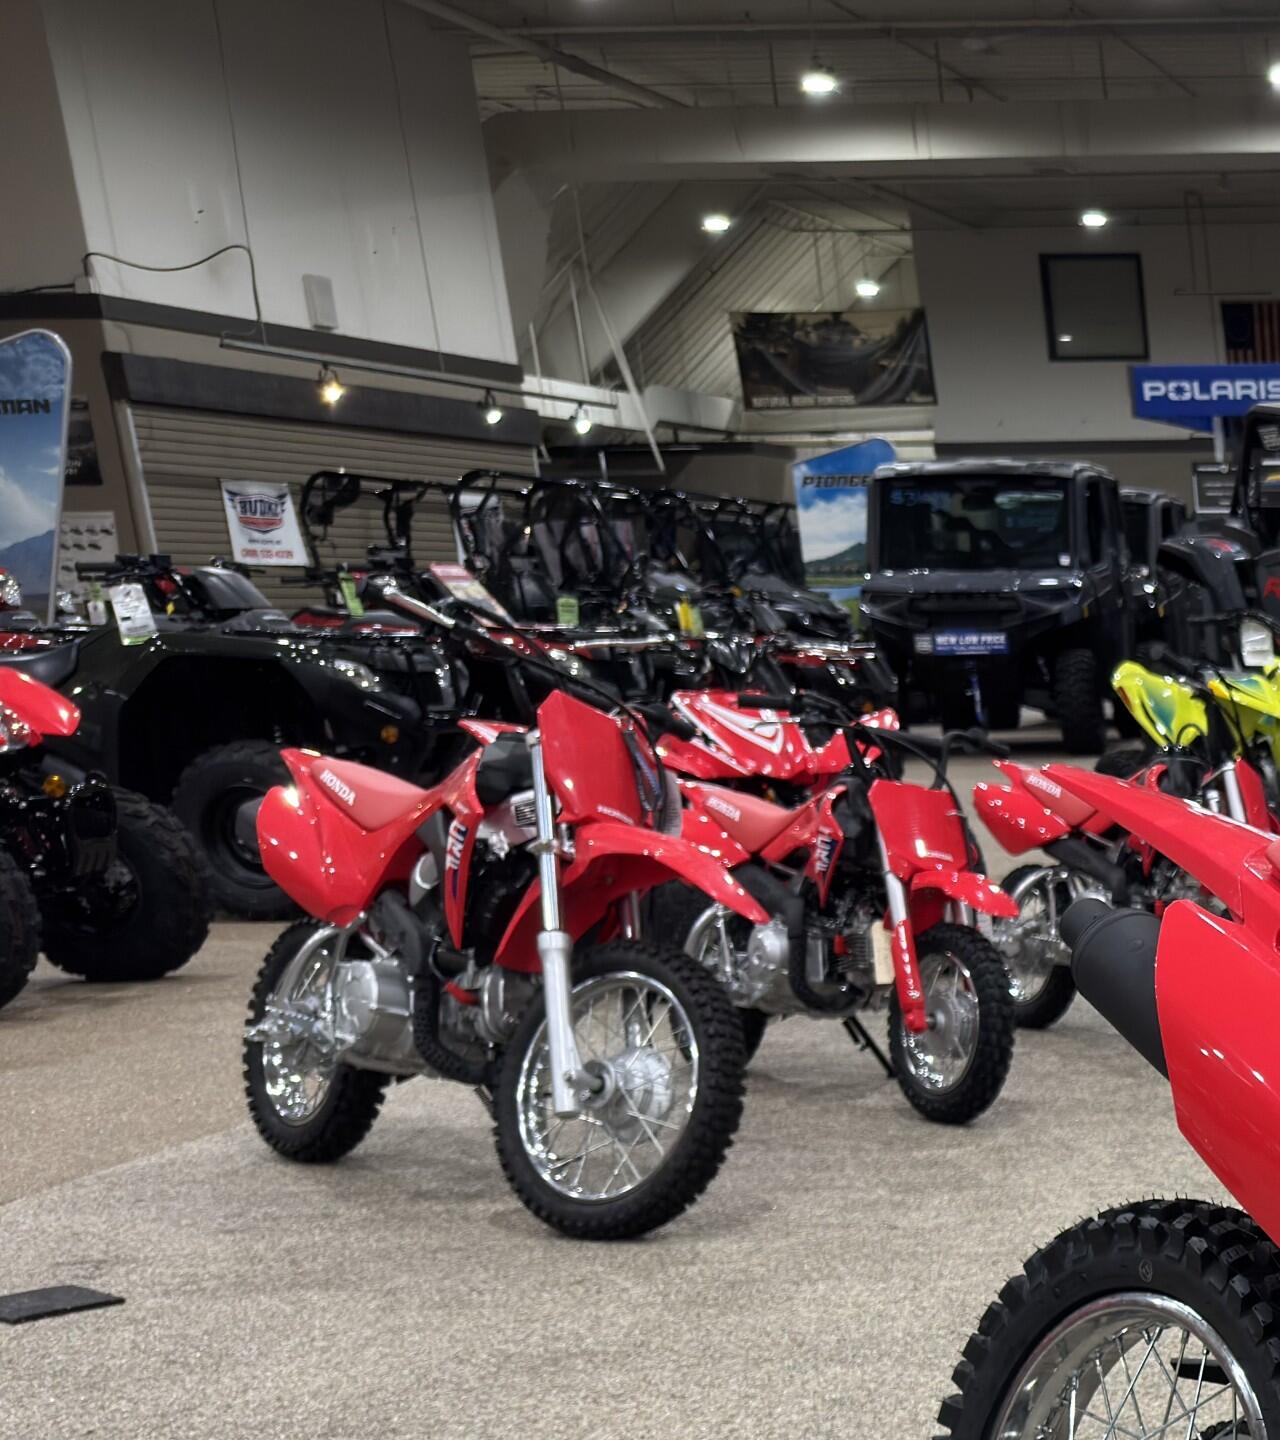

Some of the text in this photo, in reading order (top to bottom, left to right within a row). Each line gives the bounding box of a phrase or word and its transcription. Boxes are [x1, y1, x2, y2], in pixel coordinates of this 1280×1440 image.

[320, 769, 357, 807] HONDA
[1026, 775, 1062, 798] HONDA
[705, 796, 742, 822] HONDA
